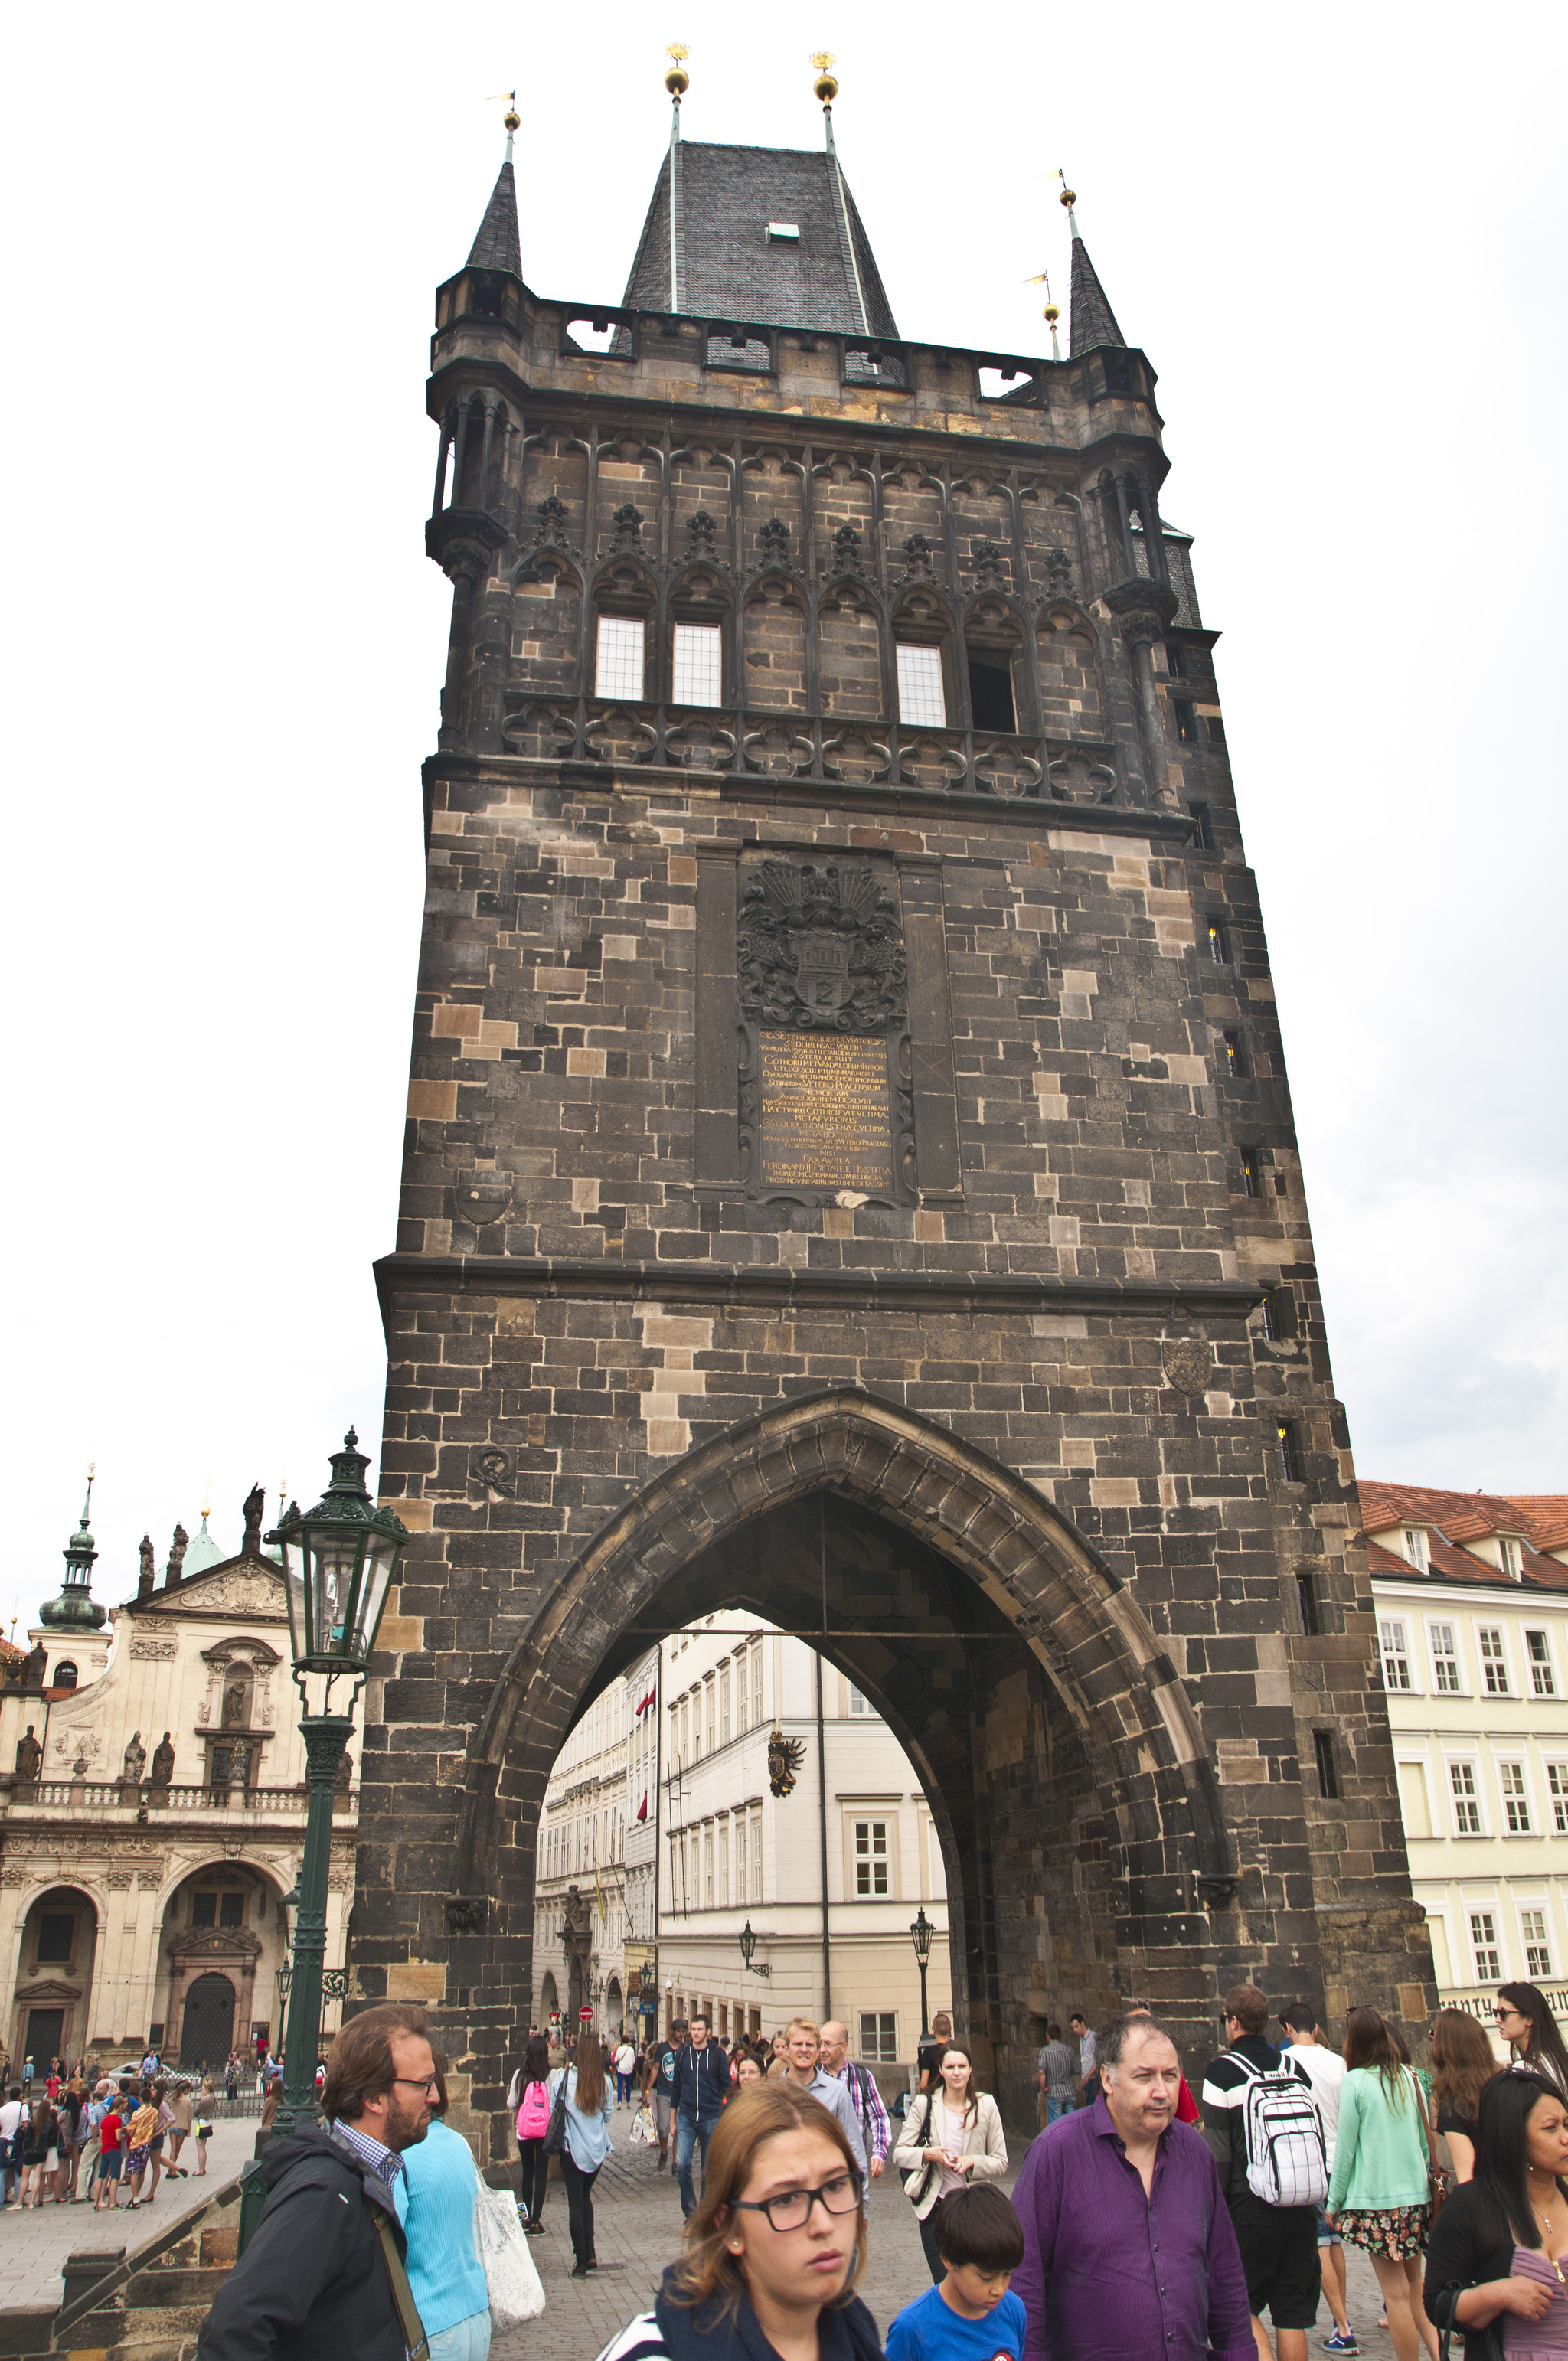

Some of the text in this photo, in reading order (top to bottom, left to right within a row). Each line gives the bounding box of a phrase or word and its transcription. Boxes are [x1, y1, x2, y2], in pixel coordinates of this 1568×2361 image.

[773, 1030, 795, 1040] SISTE
[779, 1092, 802, 1101] ANNO
[804, 1089, 848, 1097] MEMORIAM
[818, 1115, 857, 1124] FVRORIS
[803, 1154, 850, 1165] PAX AVREA
